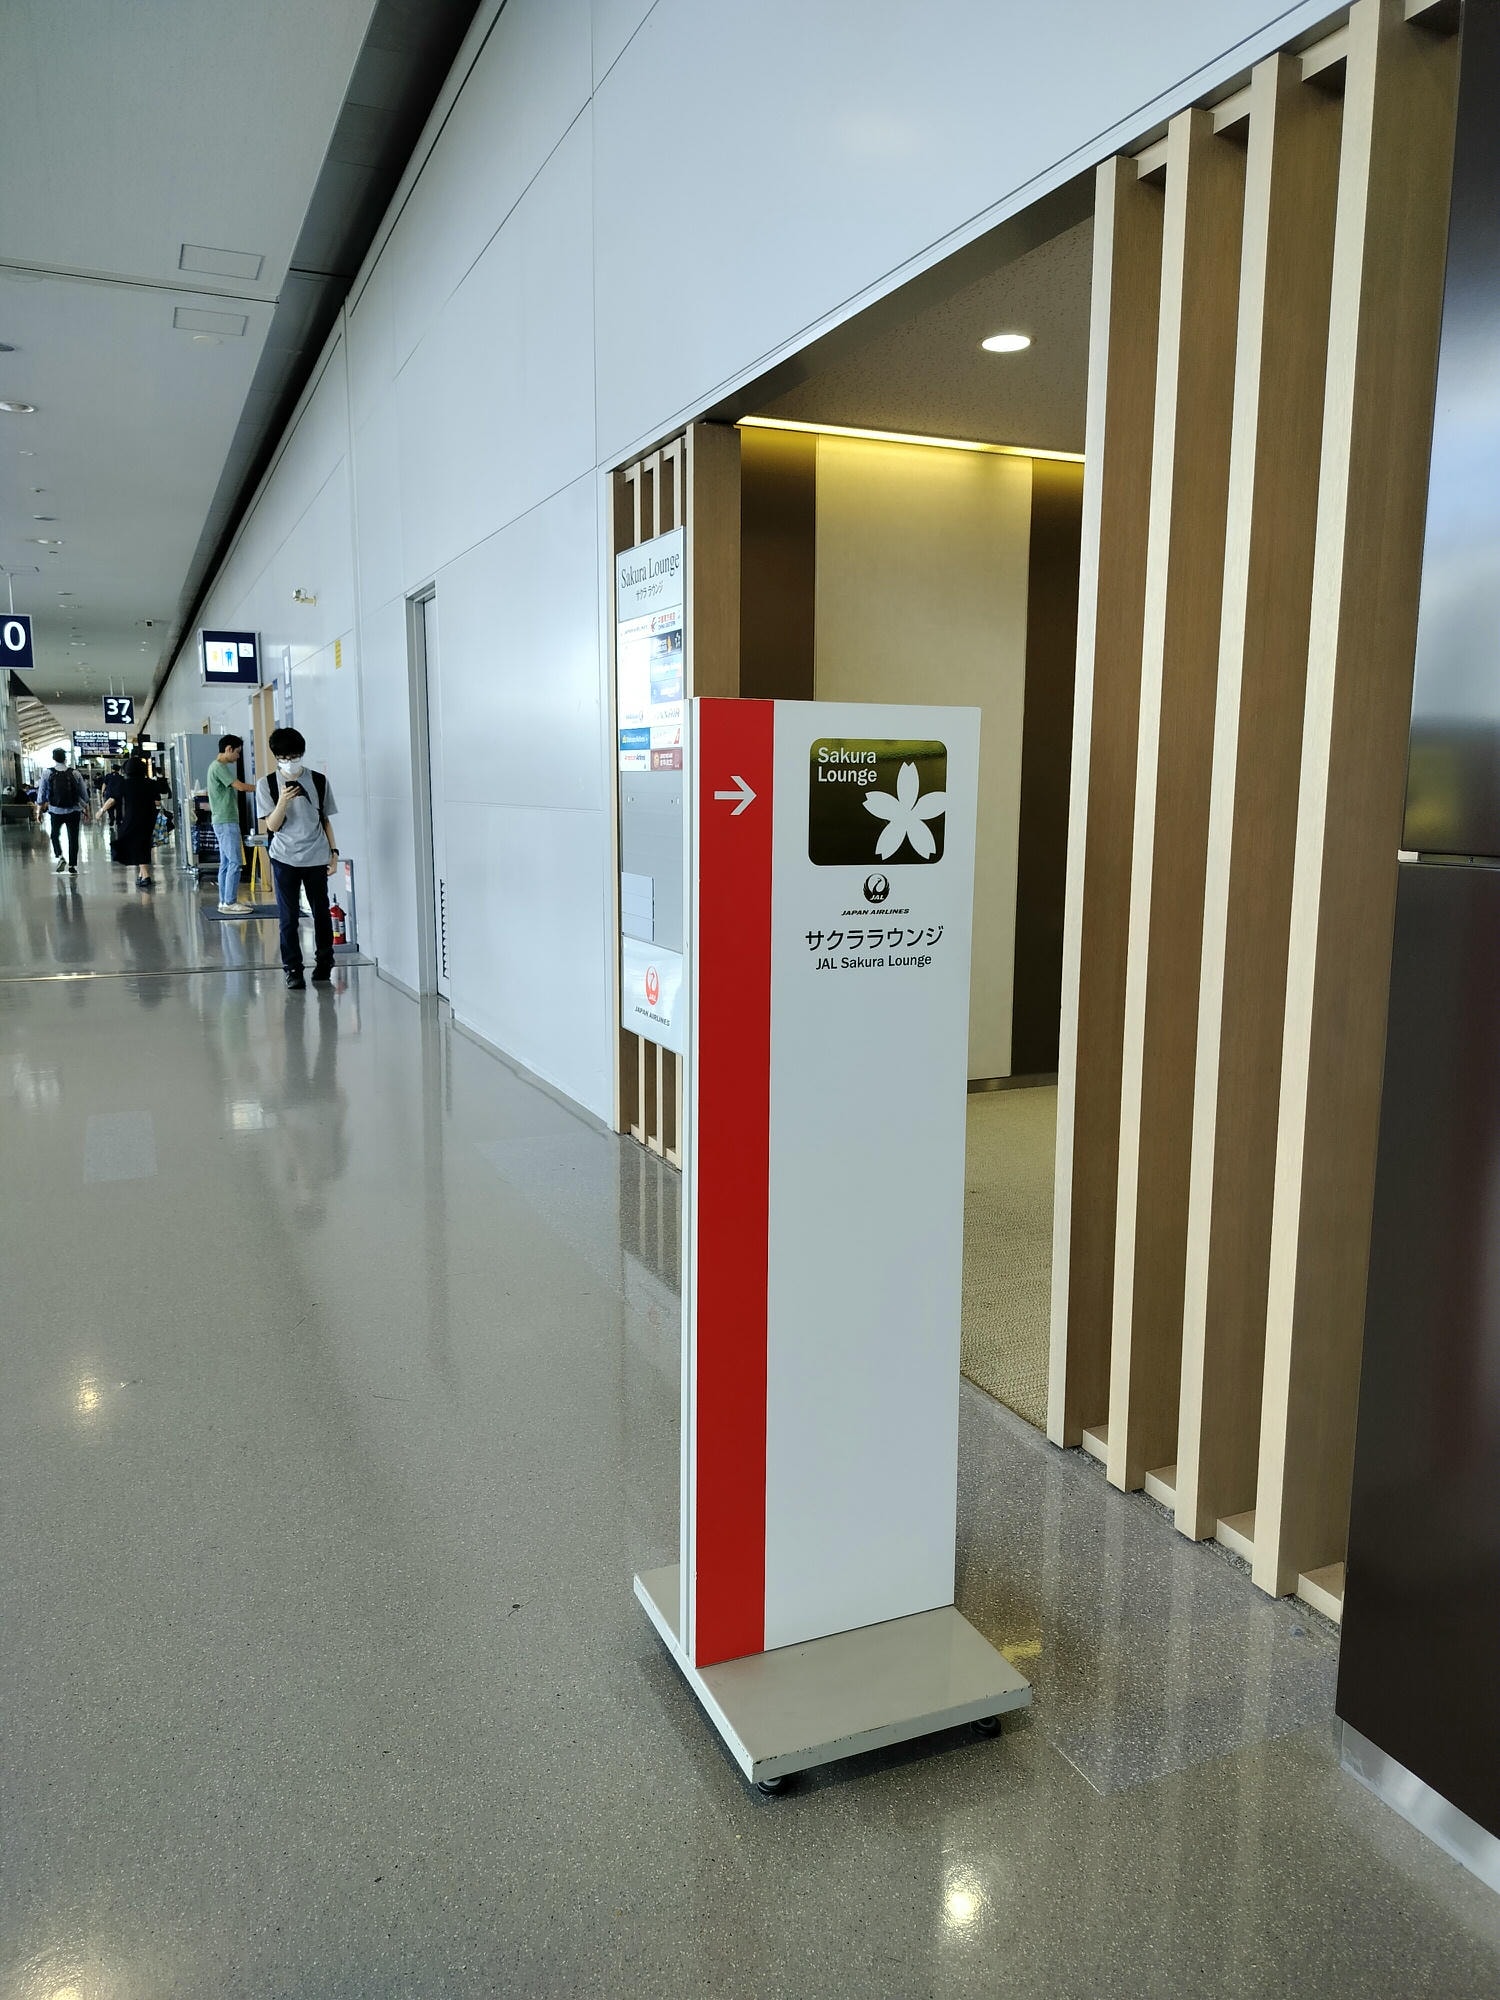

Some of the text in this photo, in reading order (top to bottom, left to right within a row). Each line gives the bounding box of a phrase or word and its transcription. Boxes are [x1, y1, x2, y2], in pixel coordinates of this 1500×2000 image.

[621, 553, 680, 589] Sakura Lounge
[0, 621, 26, 652] 0
[107, 699, 130, 715] 37
[818, 747, 876, 764] Sakura
[818, 766, 877, 786] Lounge
[805, 926, 944, 951] サクララウンジ
[816, 954, 932, 970] JAL Sakura Lounge
[634, 1006, 671, 1026] JAPAN AIRLINES
